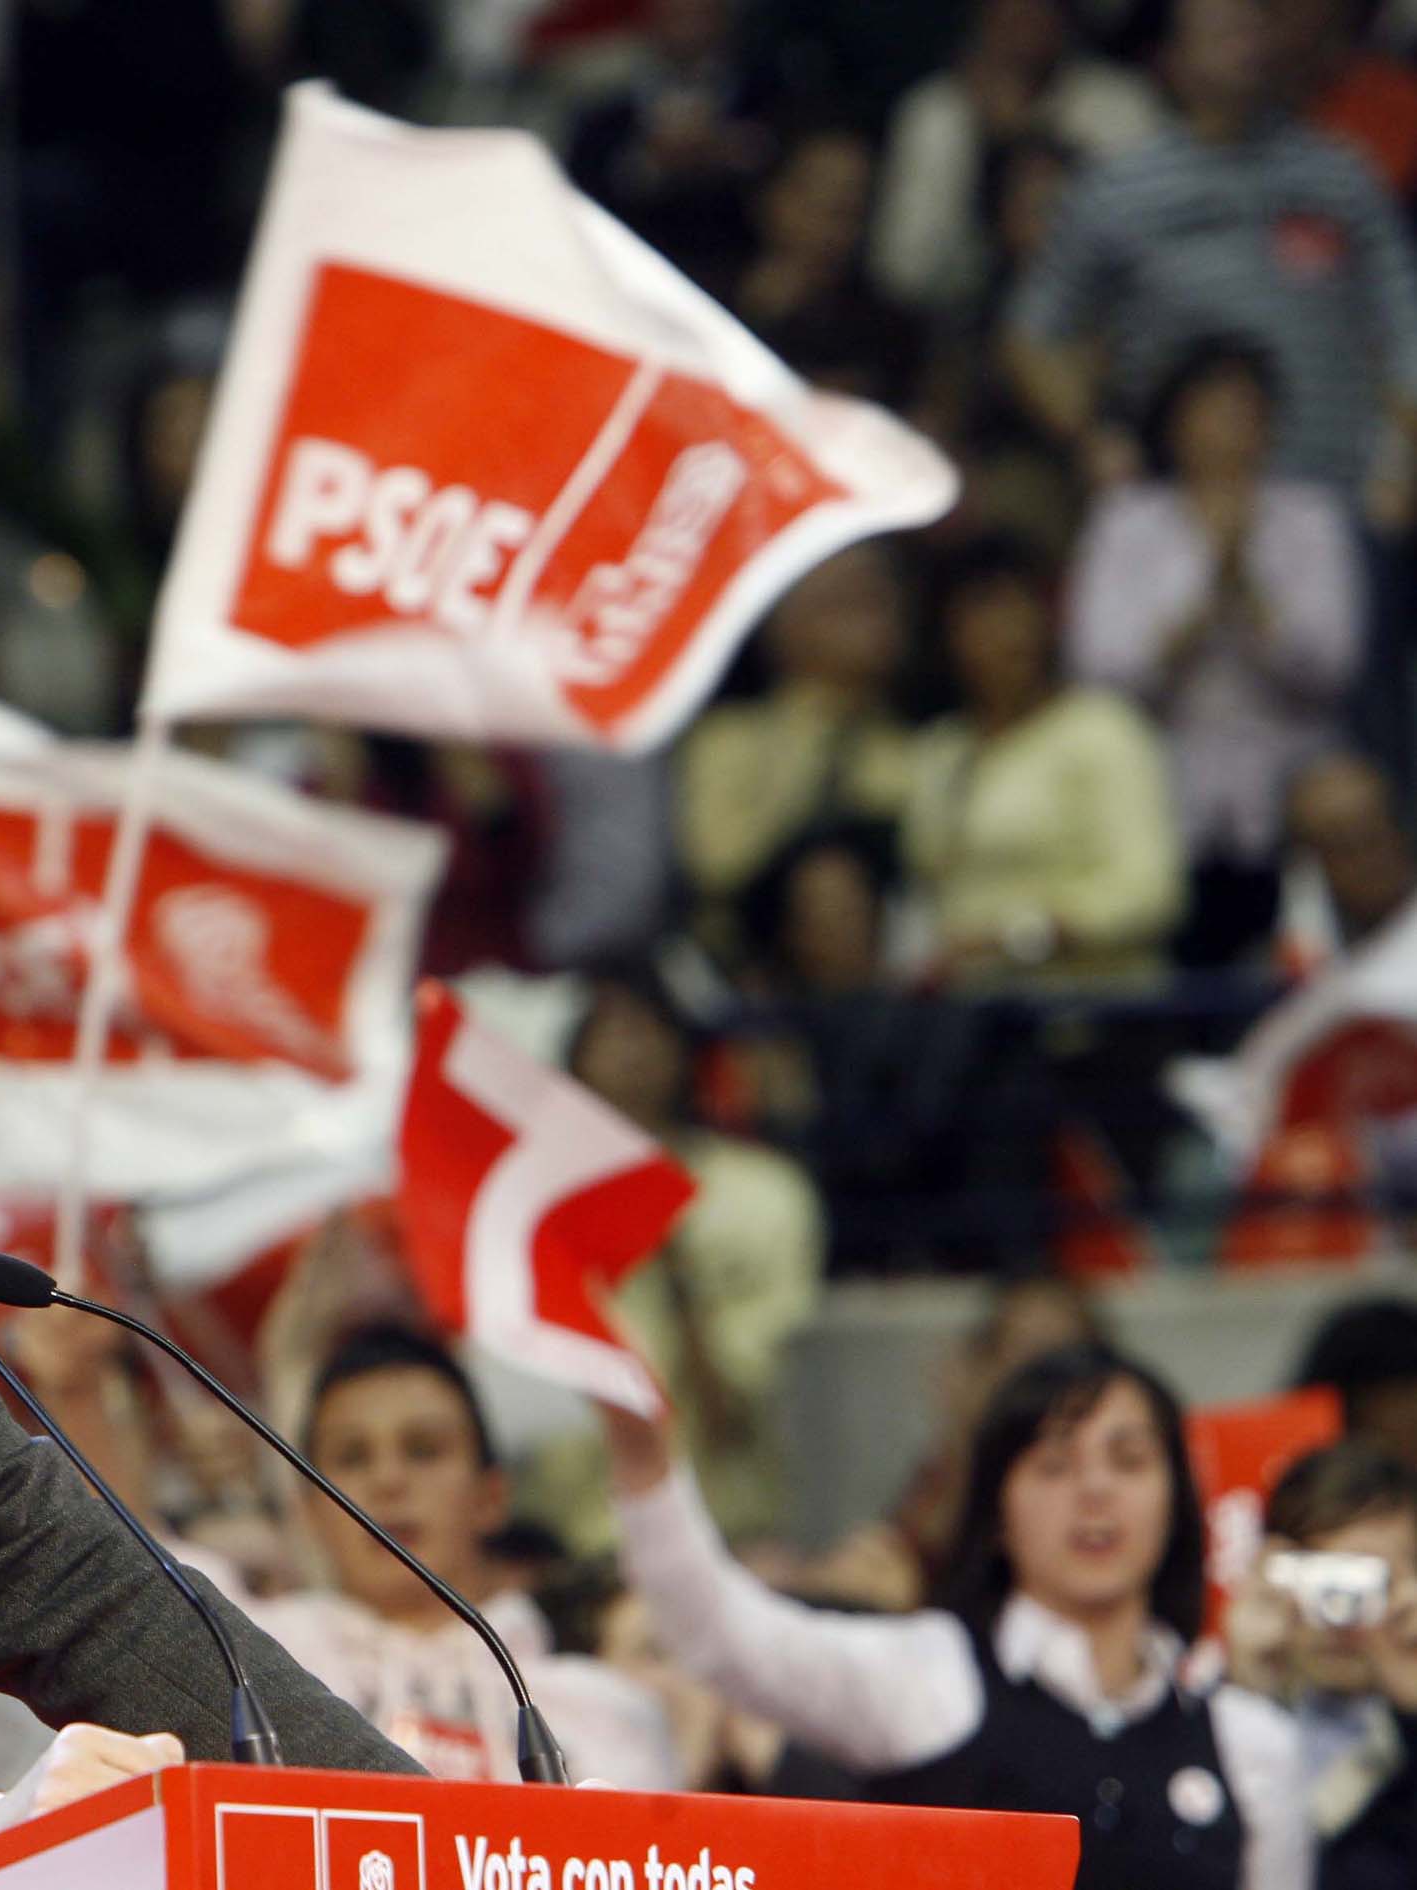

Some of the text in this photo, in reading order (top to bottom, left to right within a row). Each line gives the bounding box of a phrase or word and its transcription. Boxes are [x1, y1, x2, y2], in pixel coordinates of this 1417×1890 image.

[266, 435, 534, 633] PSOE
[454, 1834, 756, 1890] Vota con todas
